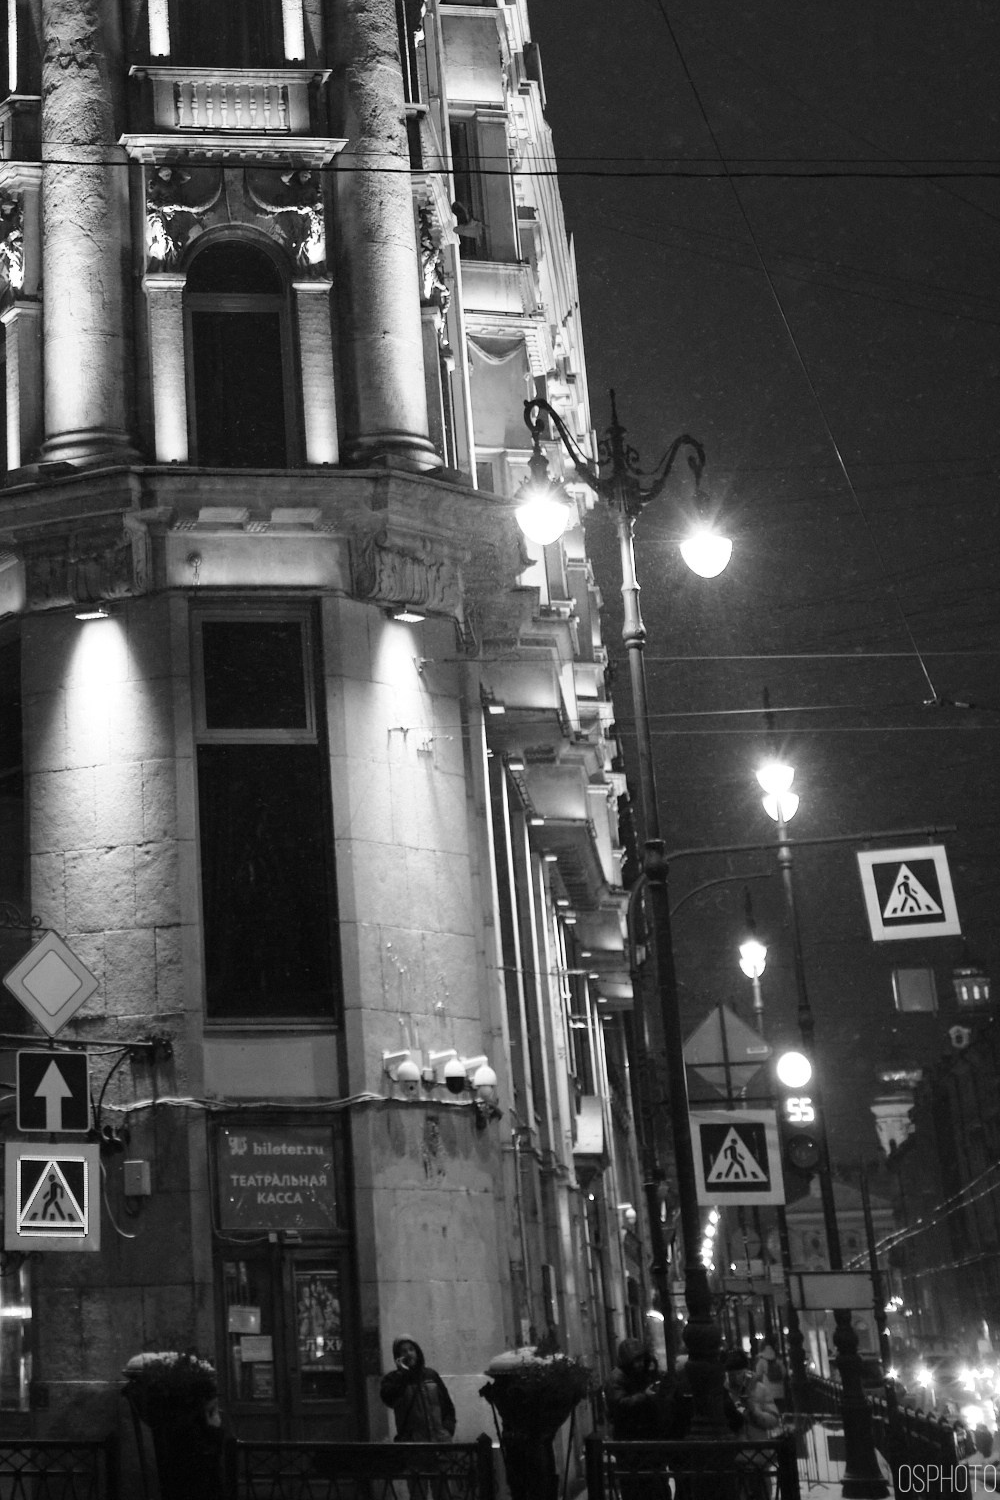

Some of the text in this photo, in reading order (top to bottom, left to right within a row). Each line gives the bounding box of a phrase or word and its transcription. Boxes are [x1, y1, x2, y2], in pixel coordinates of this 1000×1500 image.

[787, 1097, 815, 1122] 55
[252, 1141, 325, 1156] bileter.ru
[230, 1174, 328, 1187] ТЕАТРАЛЬНАЯ
[256, 1191, 304, 1205] КАССА
